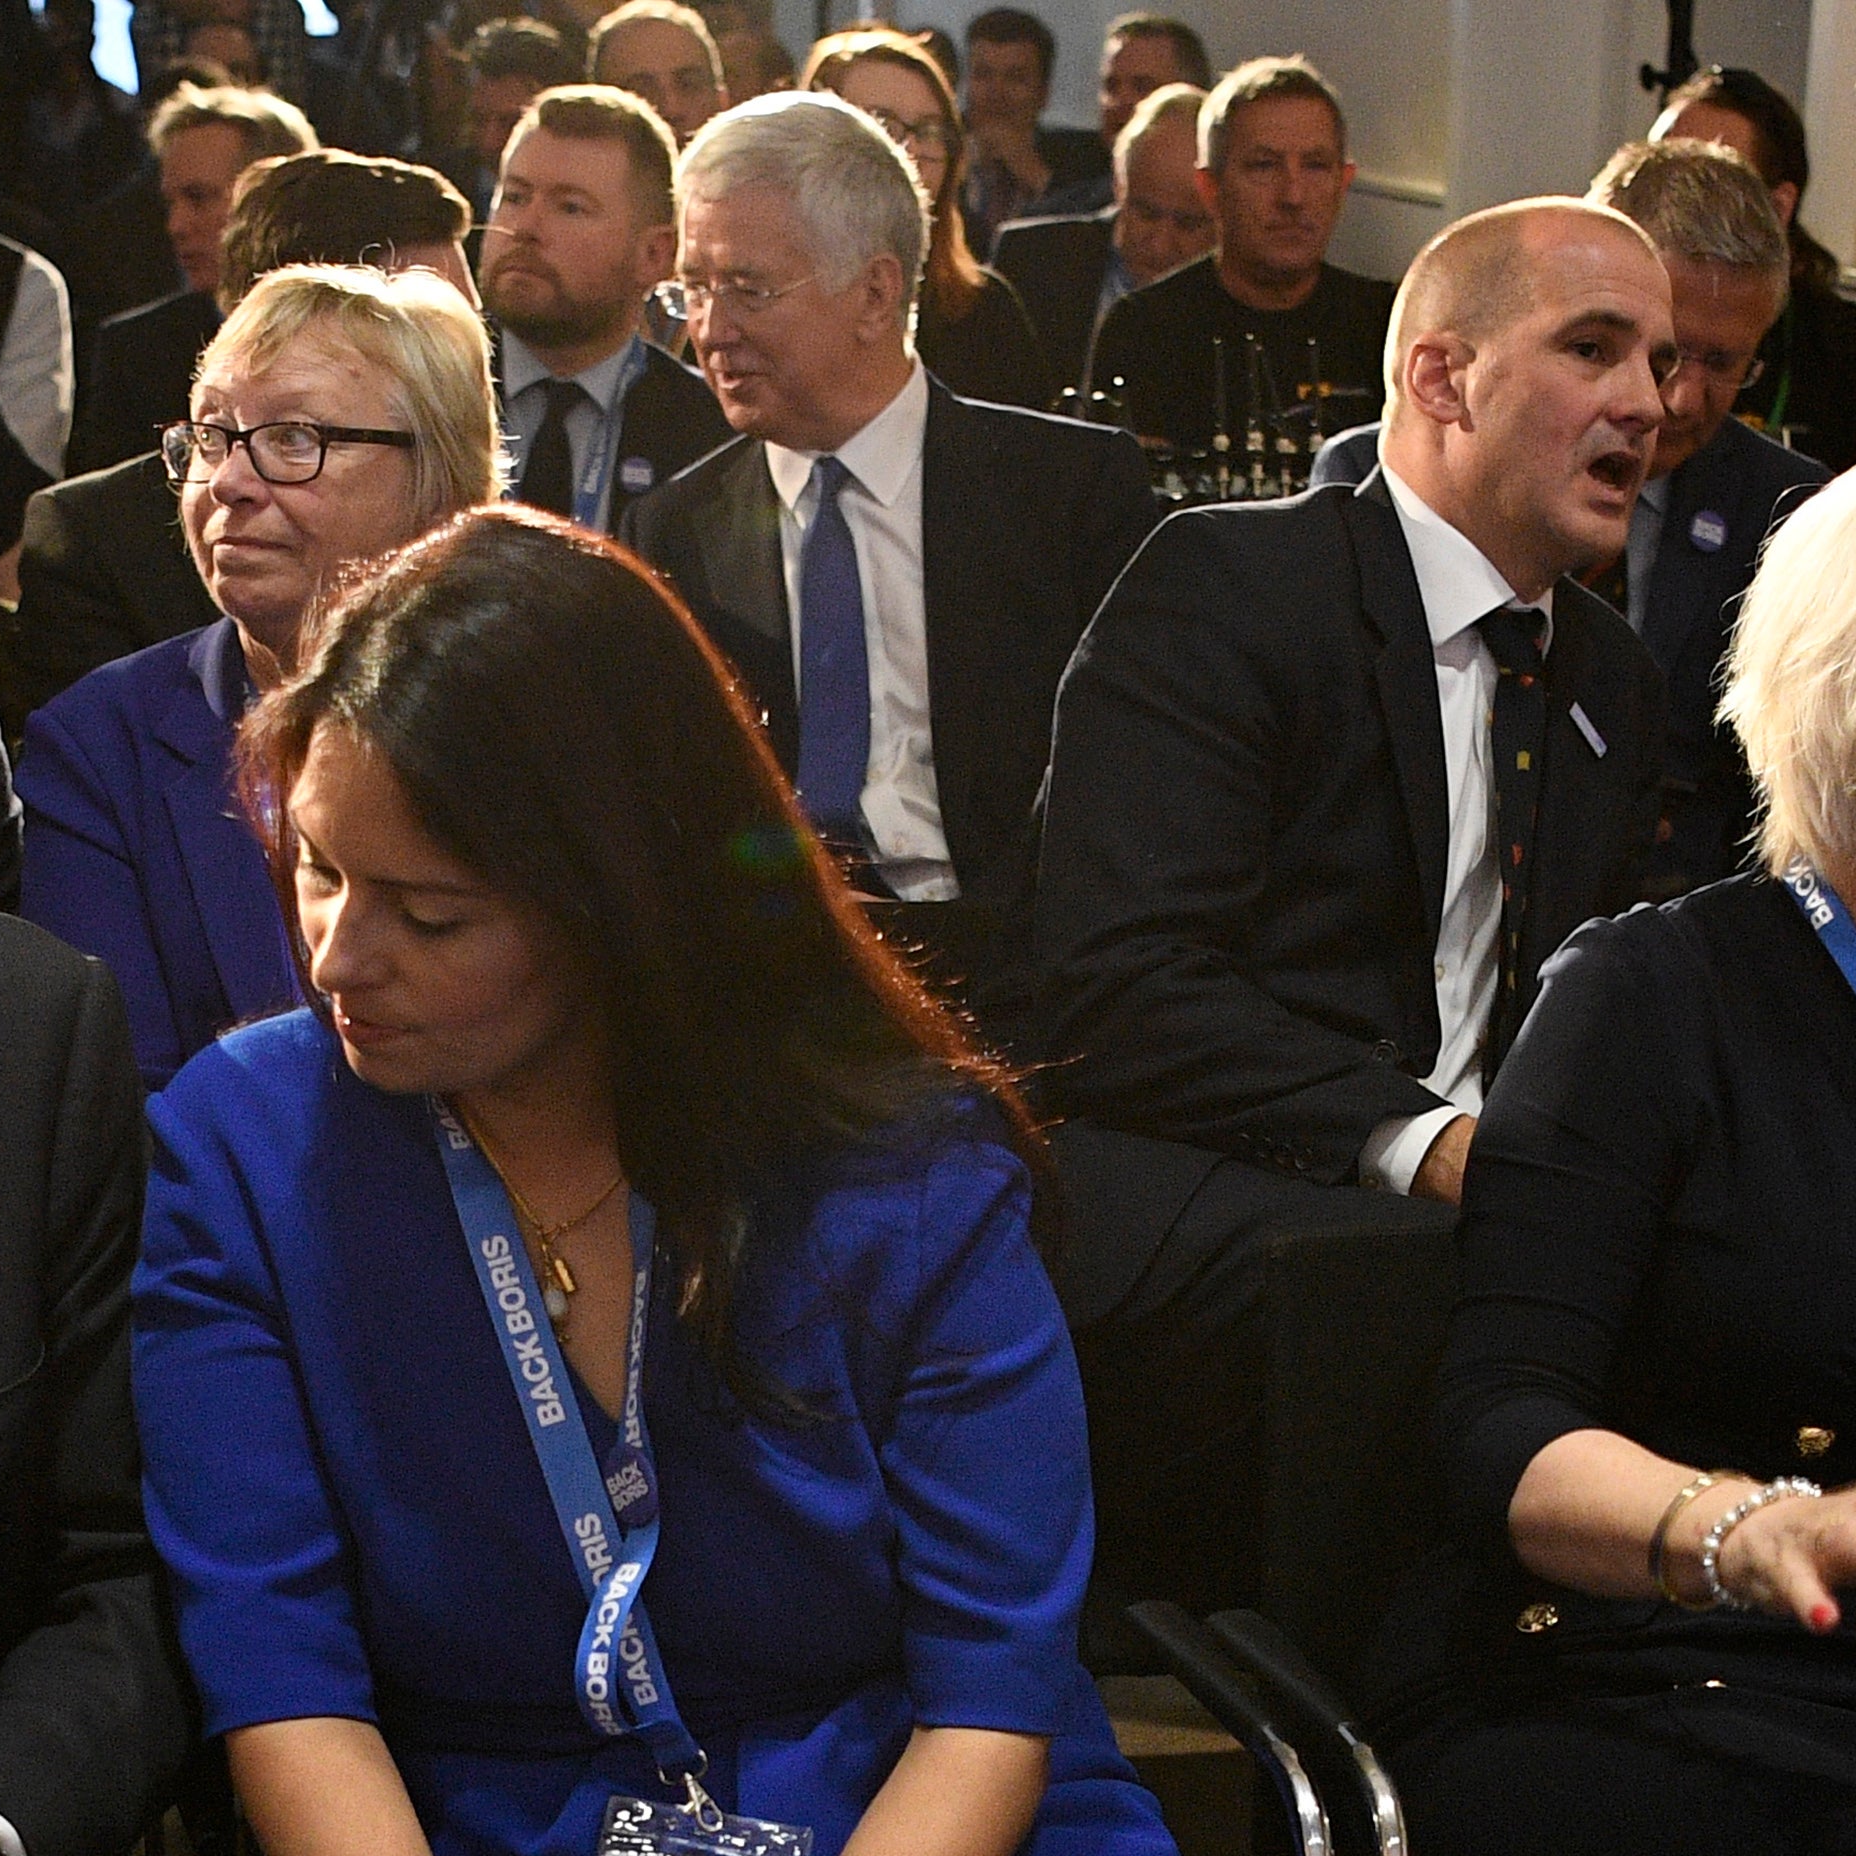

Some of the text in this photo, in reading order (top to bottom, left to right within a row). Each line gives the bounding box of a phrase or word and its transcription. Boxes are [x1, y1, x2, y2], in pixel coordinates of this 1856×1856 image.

[481, 1235, 566, 1428] BACK BORIS
[605, 1460, 644, 1496] BACK
[612, 1477, 649, 1513] BORIS
[592, 1562, 642, 1650] BACK
